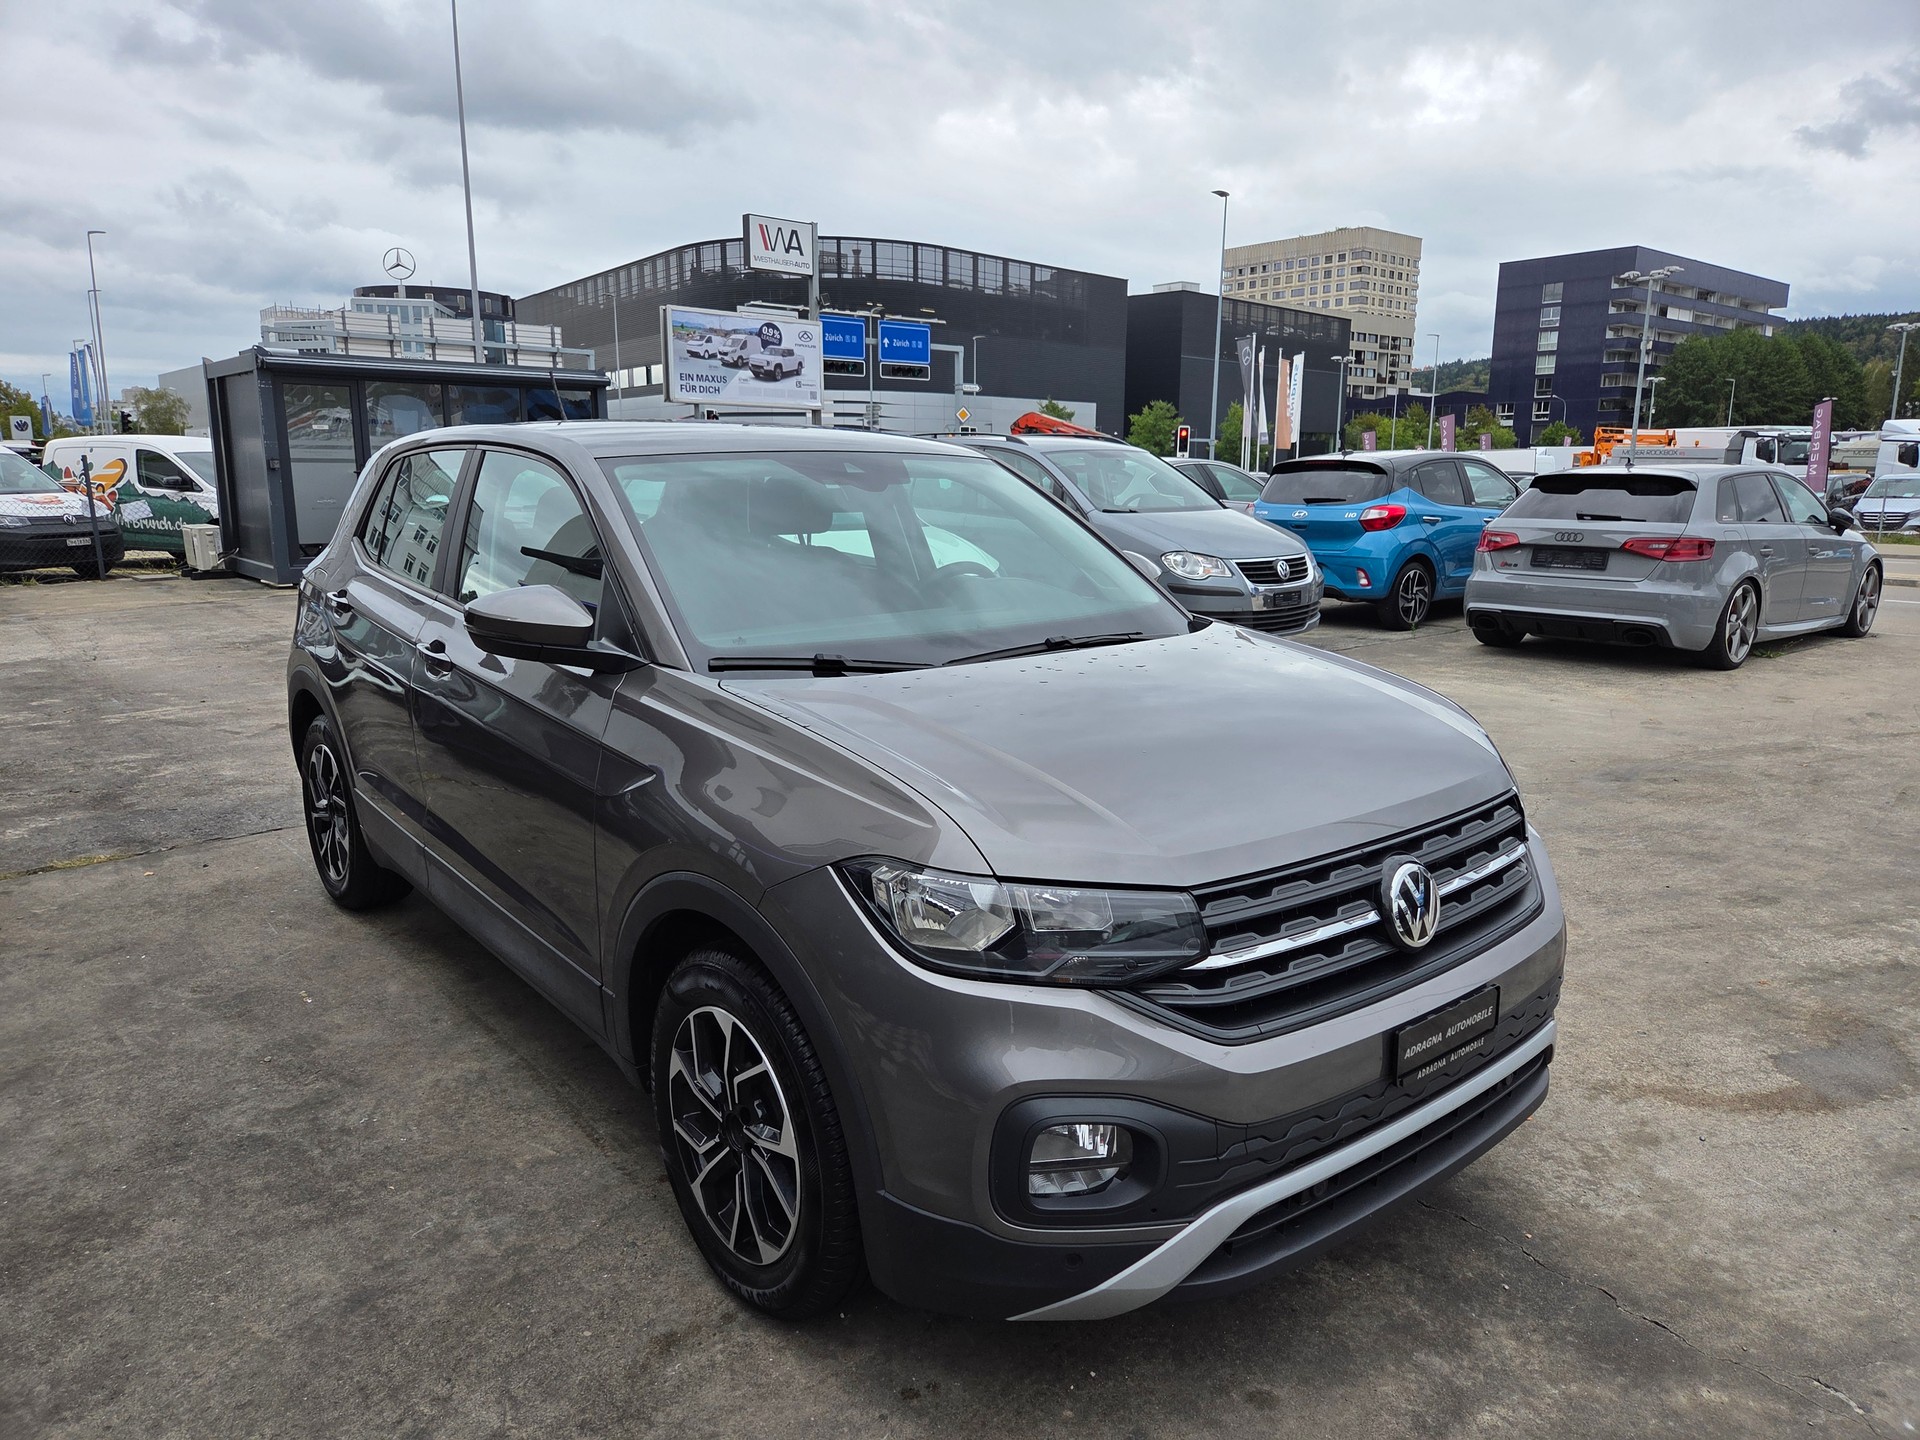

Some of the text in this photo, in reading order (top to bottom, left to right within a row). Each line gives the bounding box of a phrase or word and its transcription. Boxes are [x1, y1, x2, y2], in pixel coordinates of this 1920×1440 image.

[825, 333, 844, 342] Zürich
[892, 338, 910, 348] Zürich
[679, 372, 695, 382] EIN
[696, 374, 728, 384] MAXUS
[680, 382, 721, 395] FÜR DICH
[1404, 1005, 1494, 1060] ADRAGNA AUTOMOBILE
[1417, 1037, 1485, 1080] ADRAGNA AUTOMOBILE
